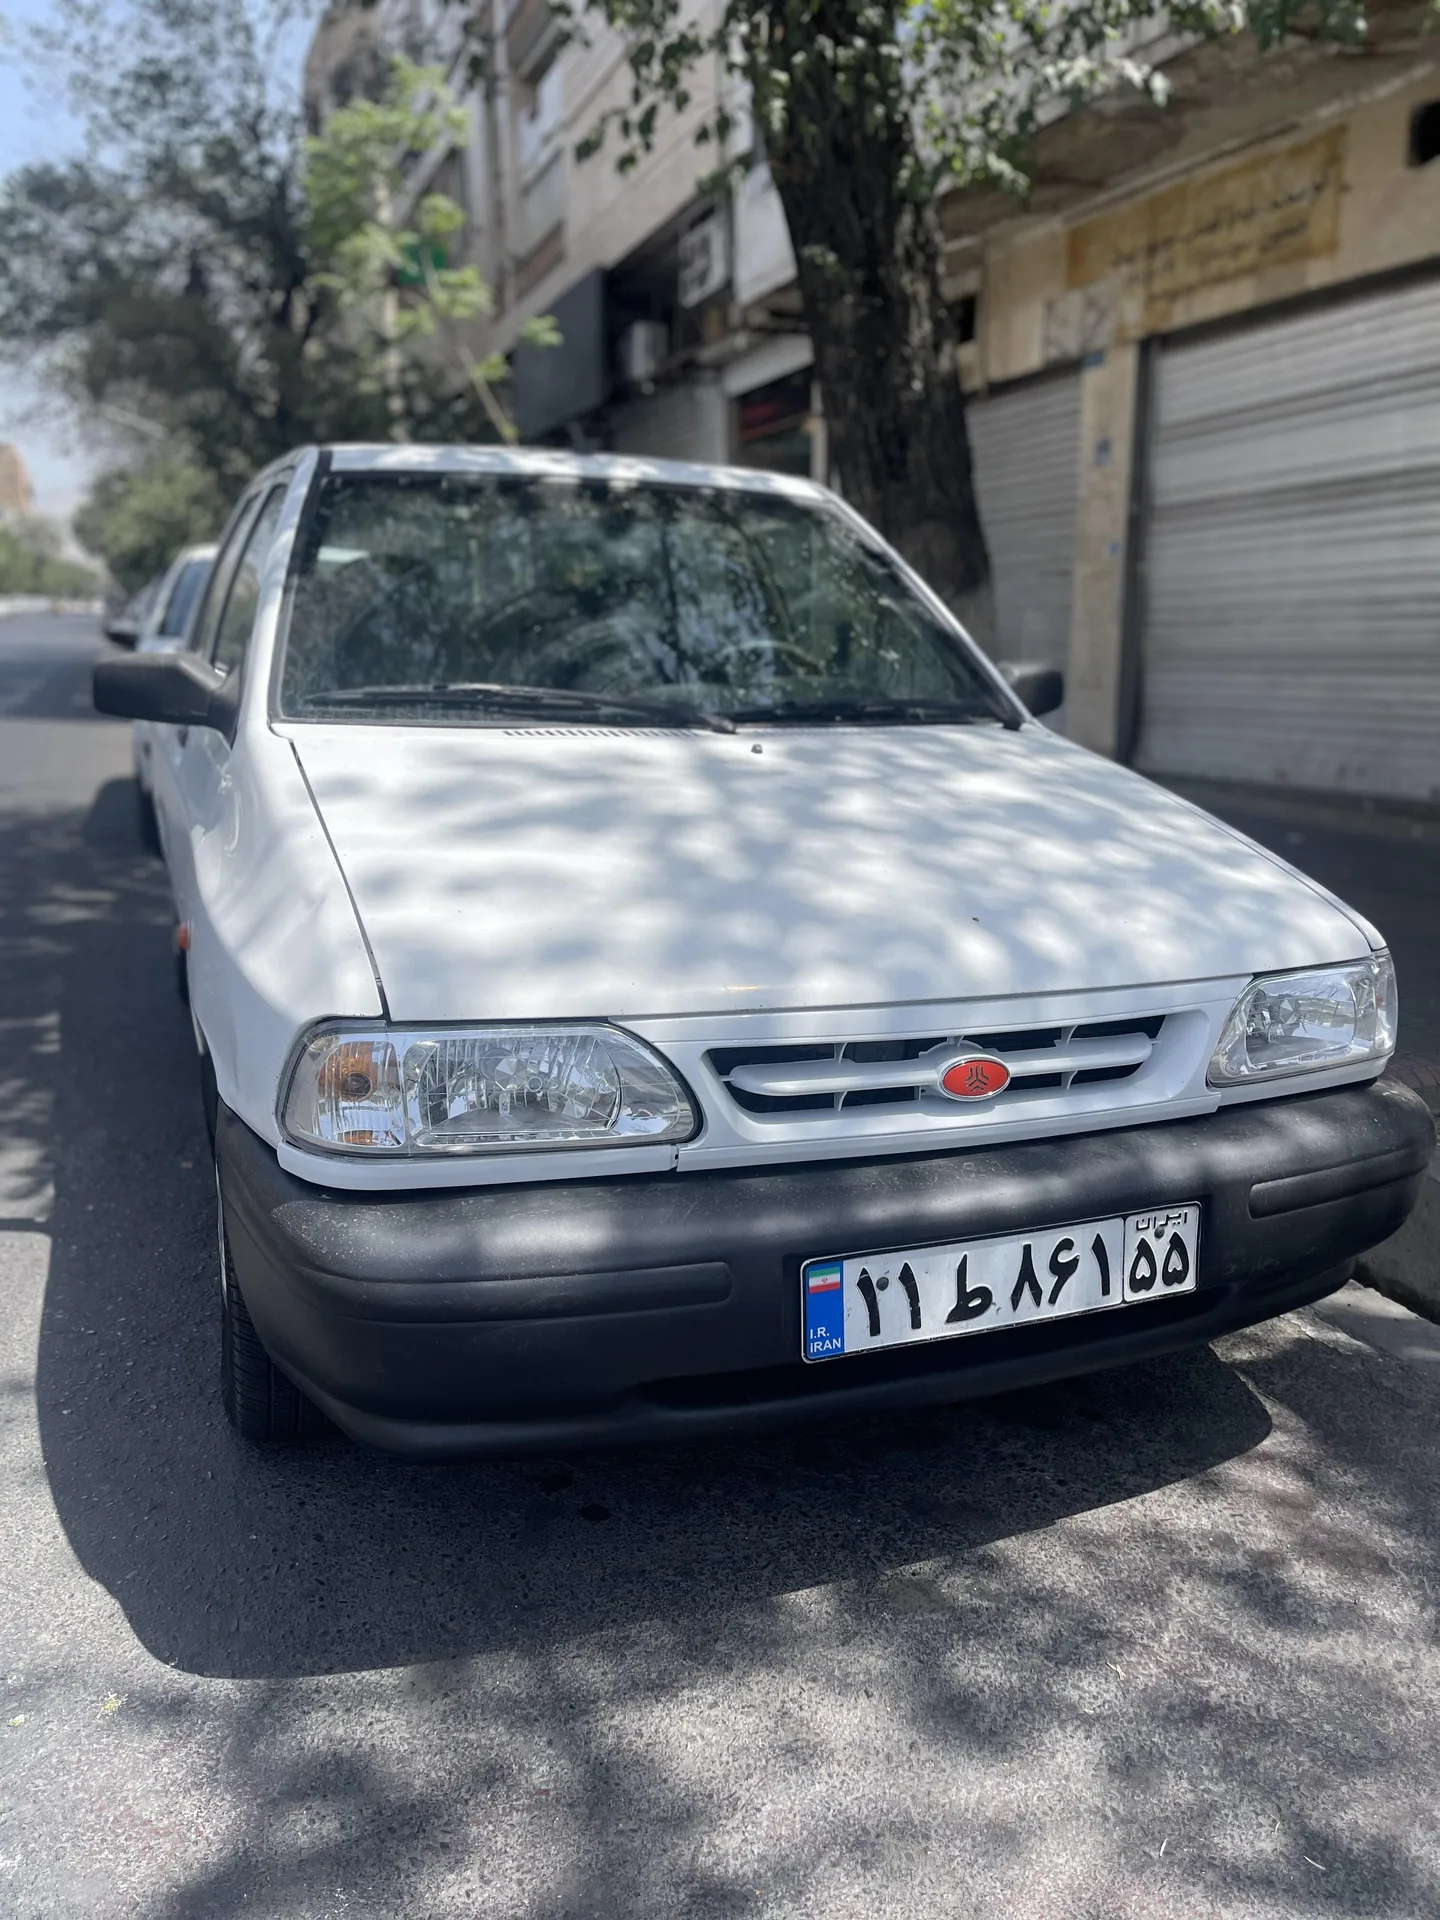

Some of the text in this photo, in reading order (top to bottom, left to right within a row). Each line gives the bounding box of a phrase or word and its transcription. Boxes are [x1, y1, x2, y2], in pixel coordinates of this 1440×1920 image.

[1135, 1210, 1188, 1231] ایران
[945, 1253, 993, 1324] ط
[1010, 1232, 1111, 1313] ۸۶۱
[1129, 1231, 1190, 1293] ۵۵
[809, 1326, 830, 1340] I.R.
